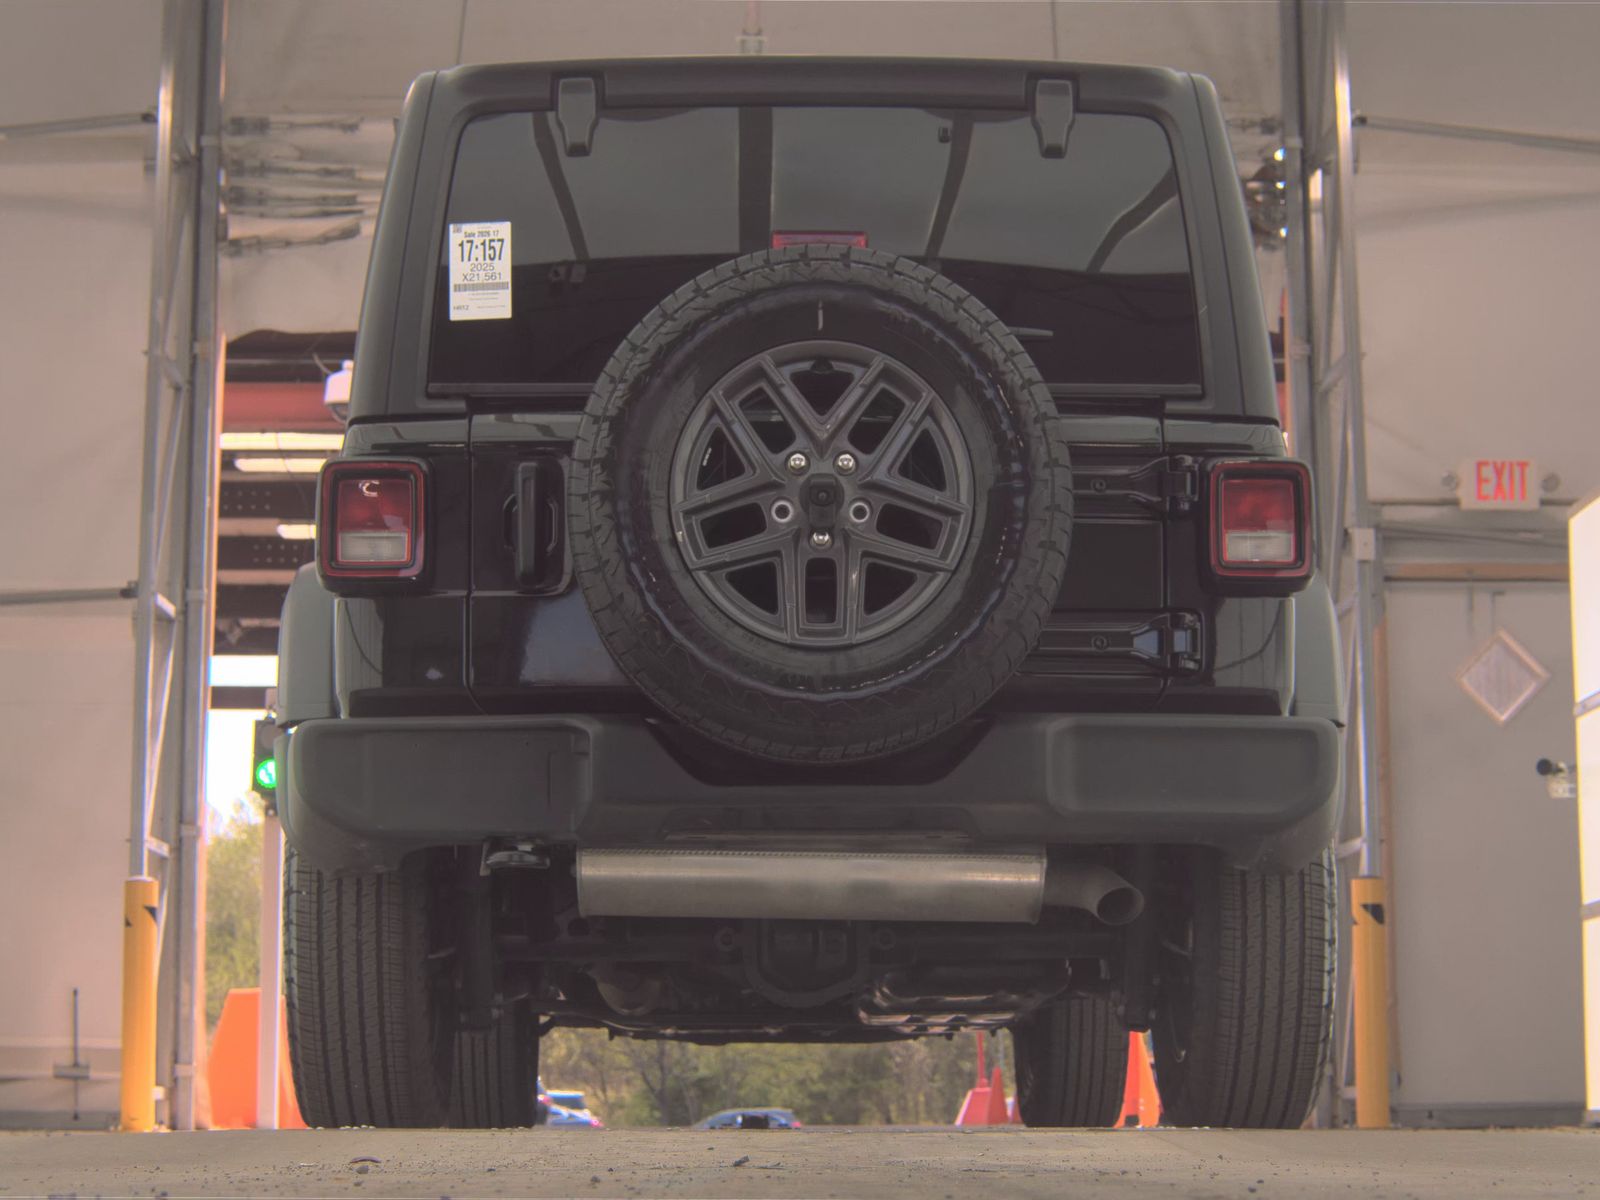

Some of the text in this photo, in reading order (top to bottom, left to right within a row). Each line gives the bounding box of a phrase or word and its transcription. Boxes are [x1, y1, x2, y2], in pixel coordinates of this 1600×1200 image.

[458, 239, 505, 262] 17:157
[470, 263, 495, 272] 2025
[1476, 461, 1529, 502] EXIT
